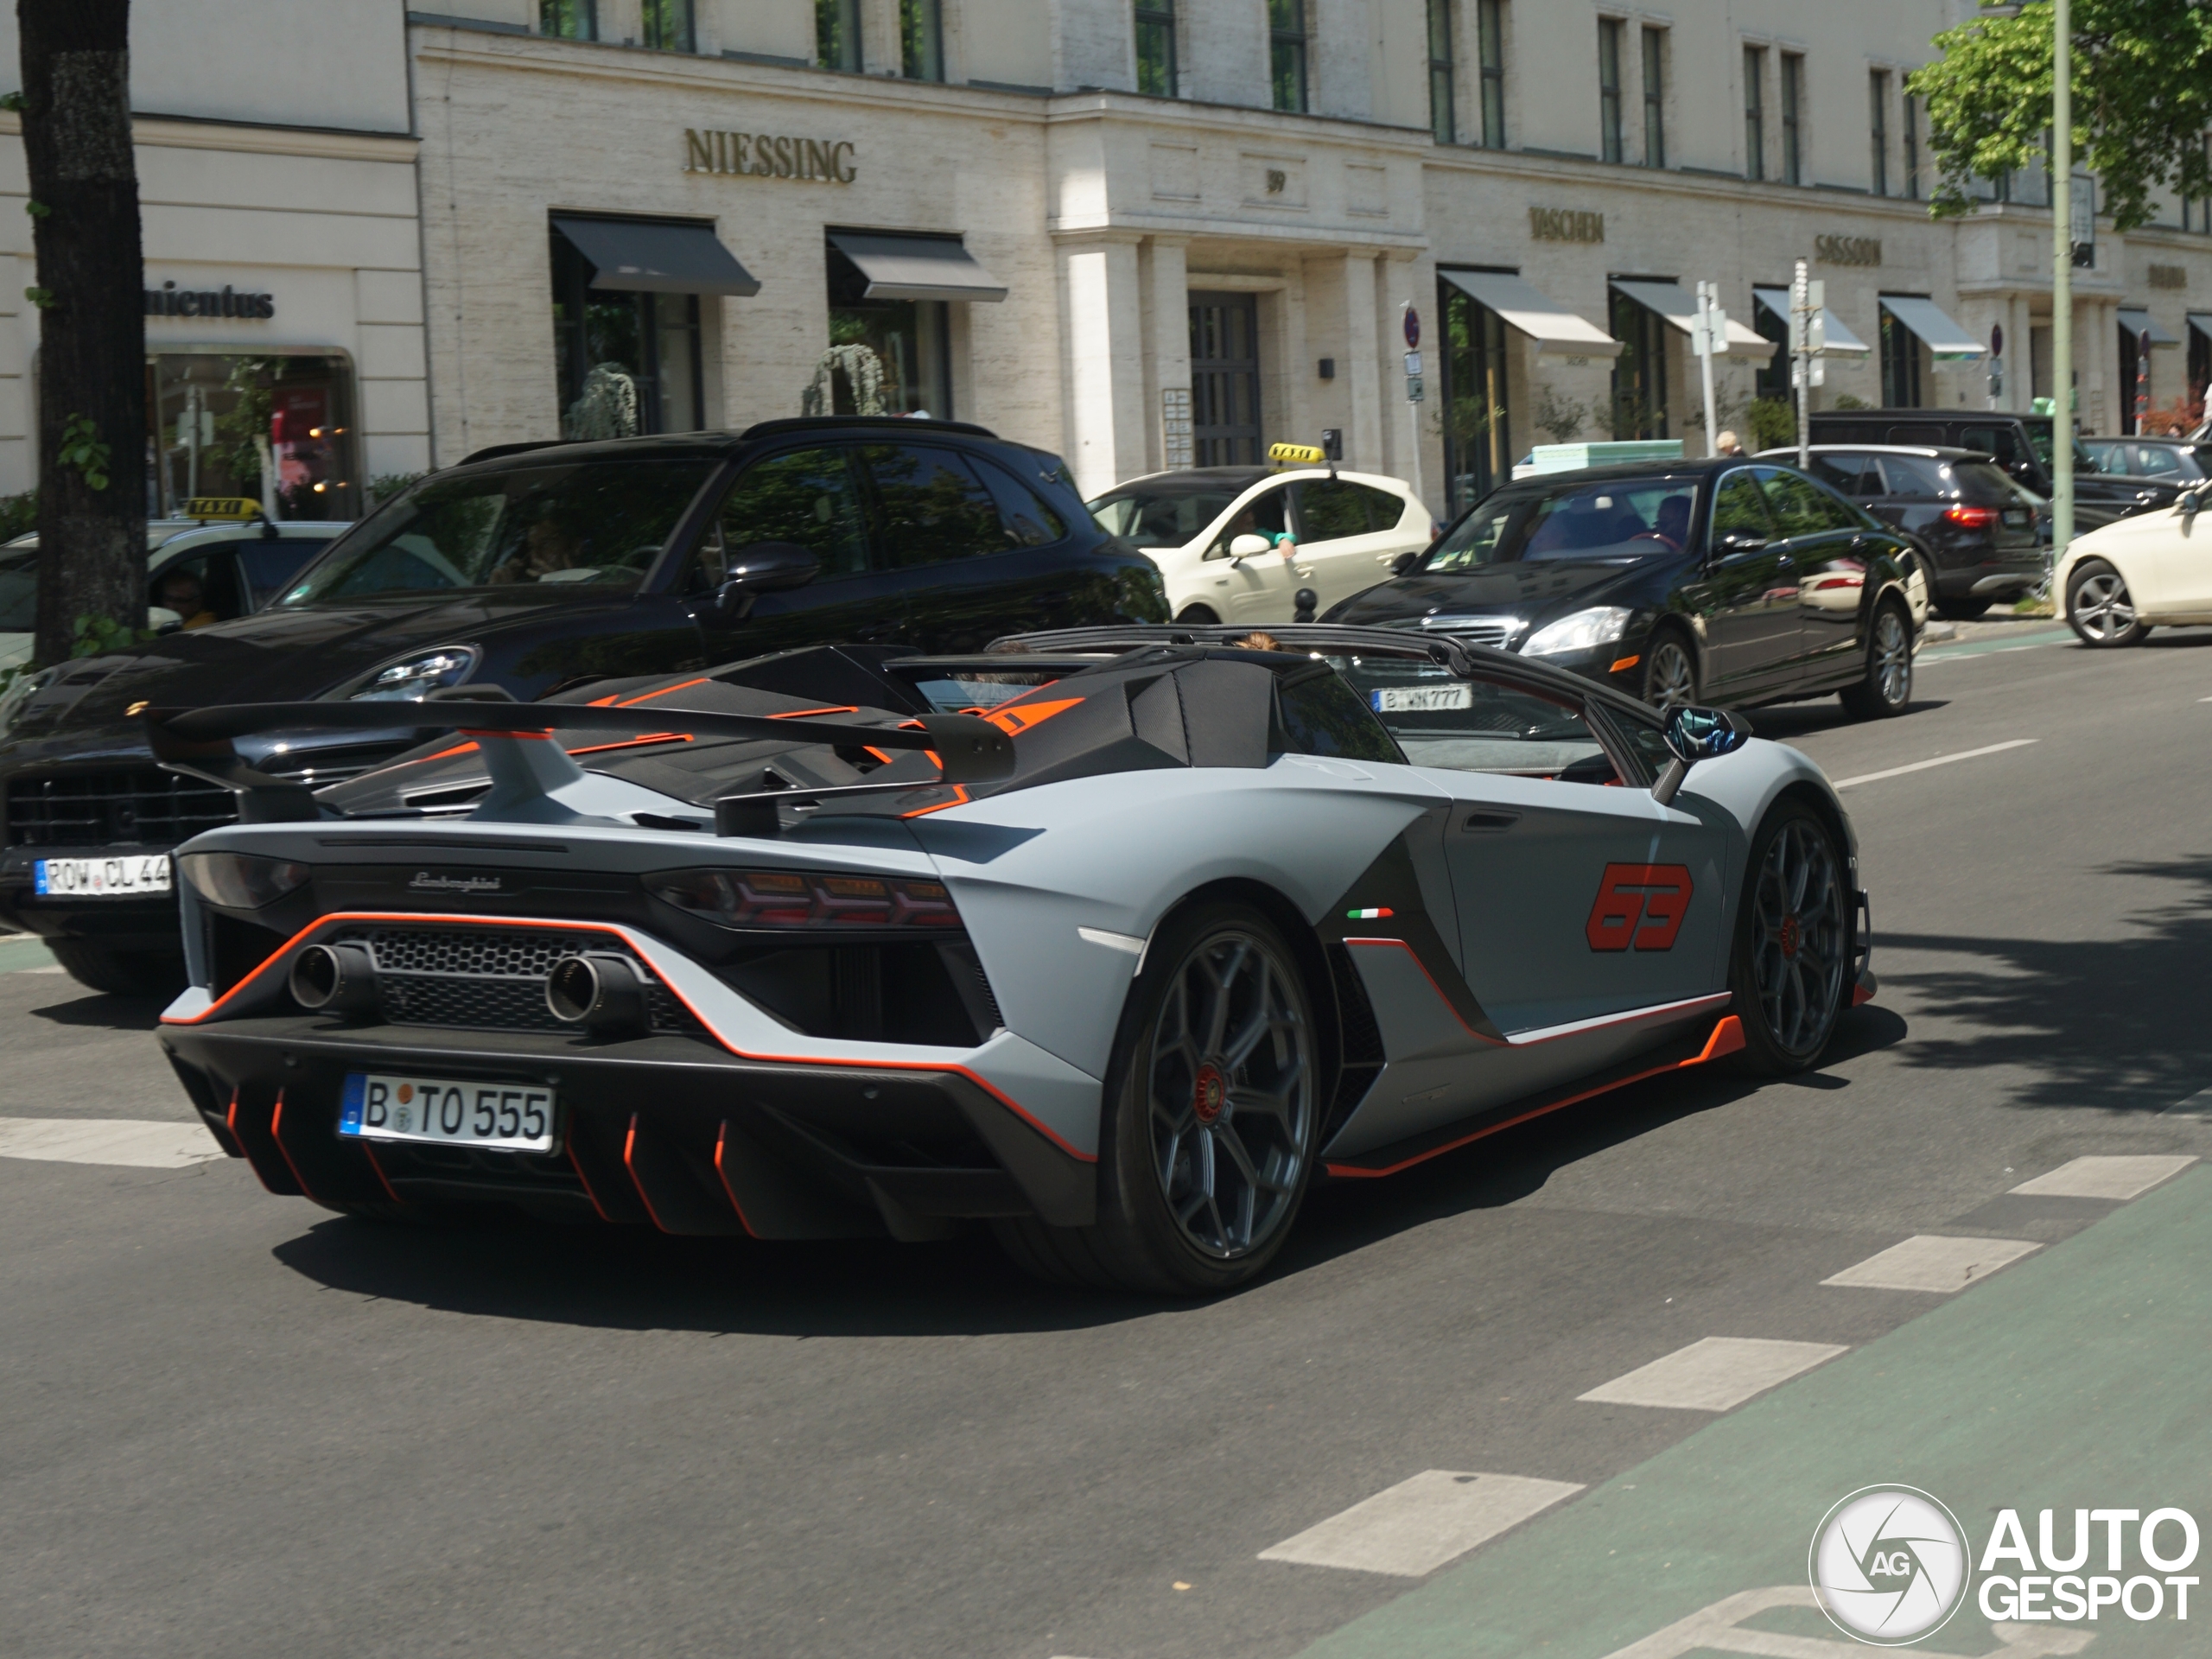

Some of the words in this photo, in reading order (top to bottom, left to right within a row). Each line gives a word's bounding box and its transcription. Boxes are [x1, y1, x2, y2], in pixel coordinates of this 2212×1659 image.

[684, 128, 858, 183] NIESSING
[1528, 207, 1604, 243] TASCHEN
[1273, 446, 1312, 460] TAXI
[189, 500, 243, 515] TAXI
[49, 862, 88, 891] ROW
[105, 860, 133, 888] CL
[141, 857, 168, 886] 44
[1586, 862, 1694, 952] 63
[365, 1082, 389, 1128] B
[418, 1084, 464, 1135] TO
[473, 1090, 548, 1141] 555
